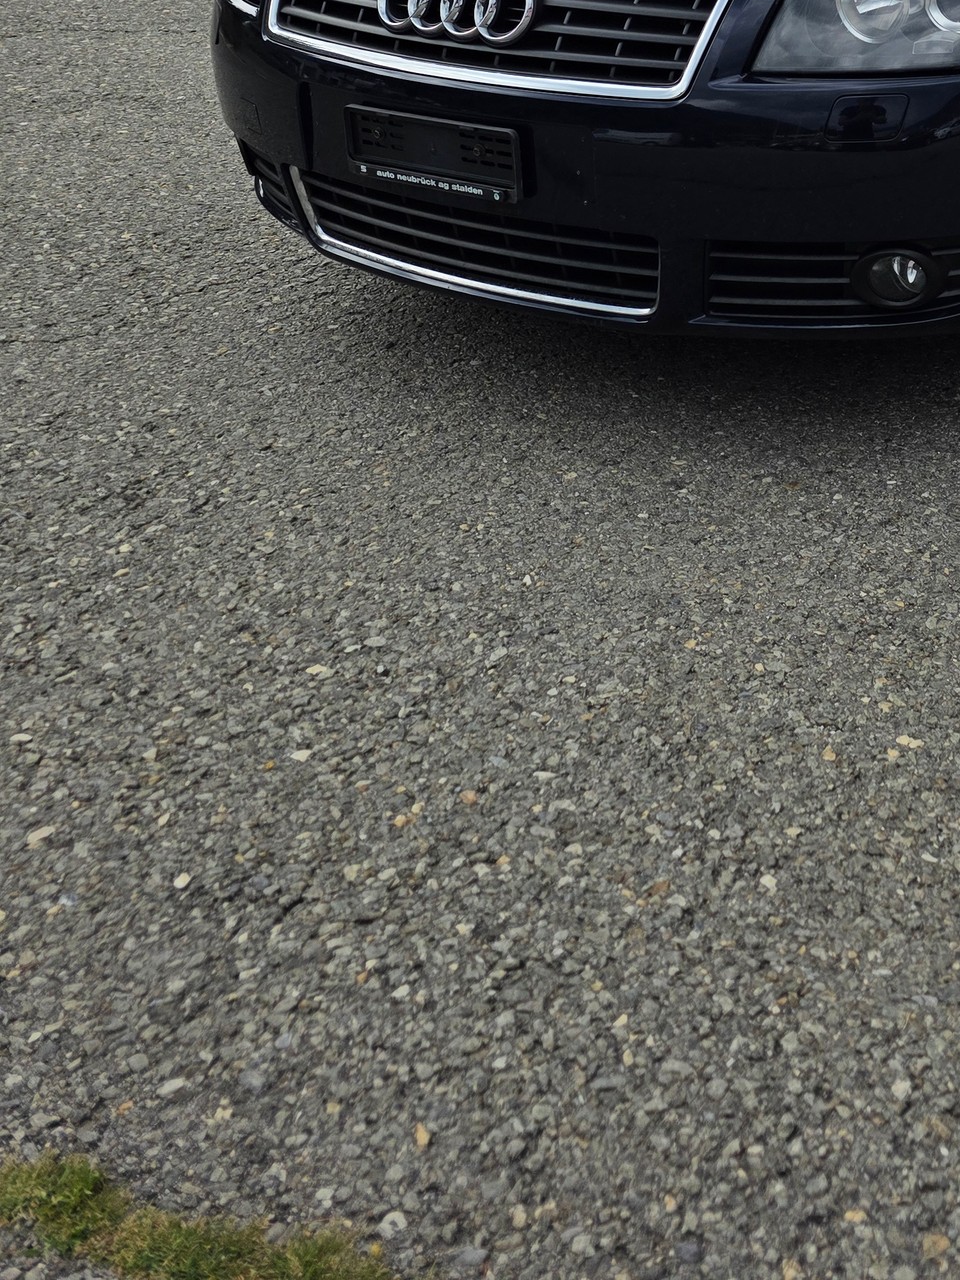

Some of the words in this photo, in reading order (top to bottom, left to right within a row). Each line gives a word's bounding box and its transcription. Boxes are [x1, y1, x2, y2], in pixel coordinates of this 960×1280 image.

[376, 170, 395, 179] auto
[397, 173, 437, 187] neubrück
[438, 181, 450, 191] ag
[452, 183, 483, 196] stalden
